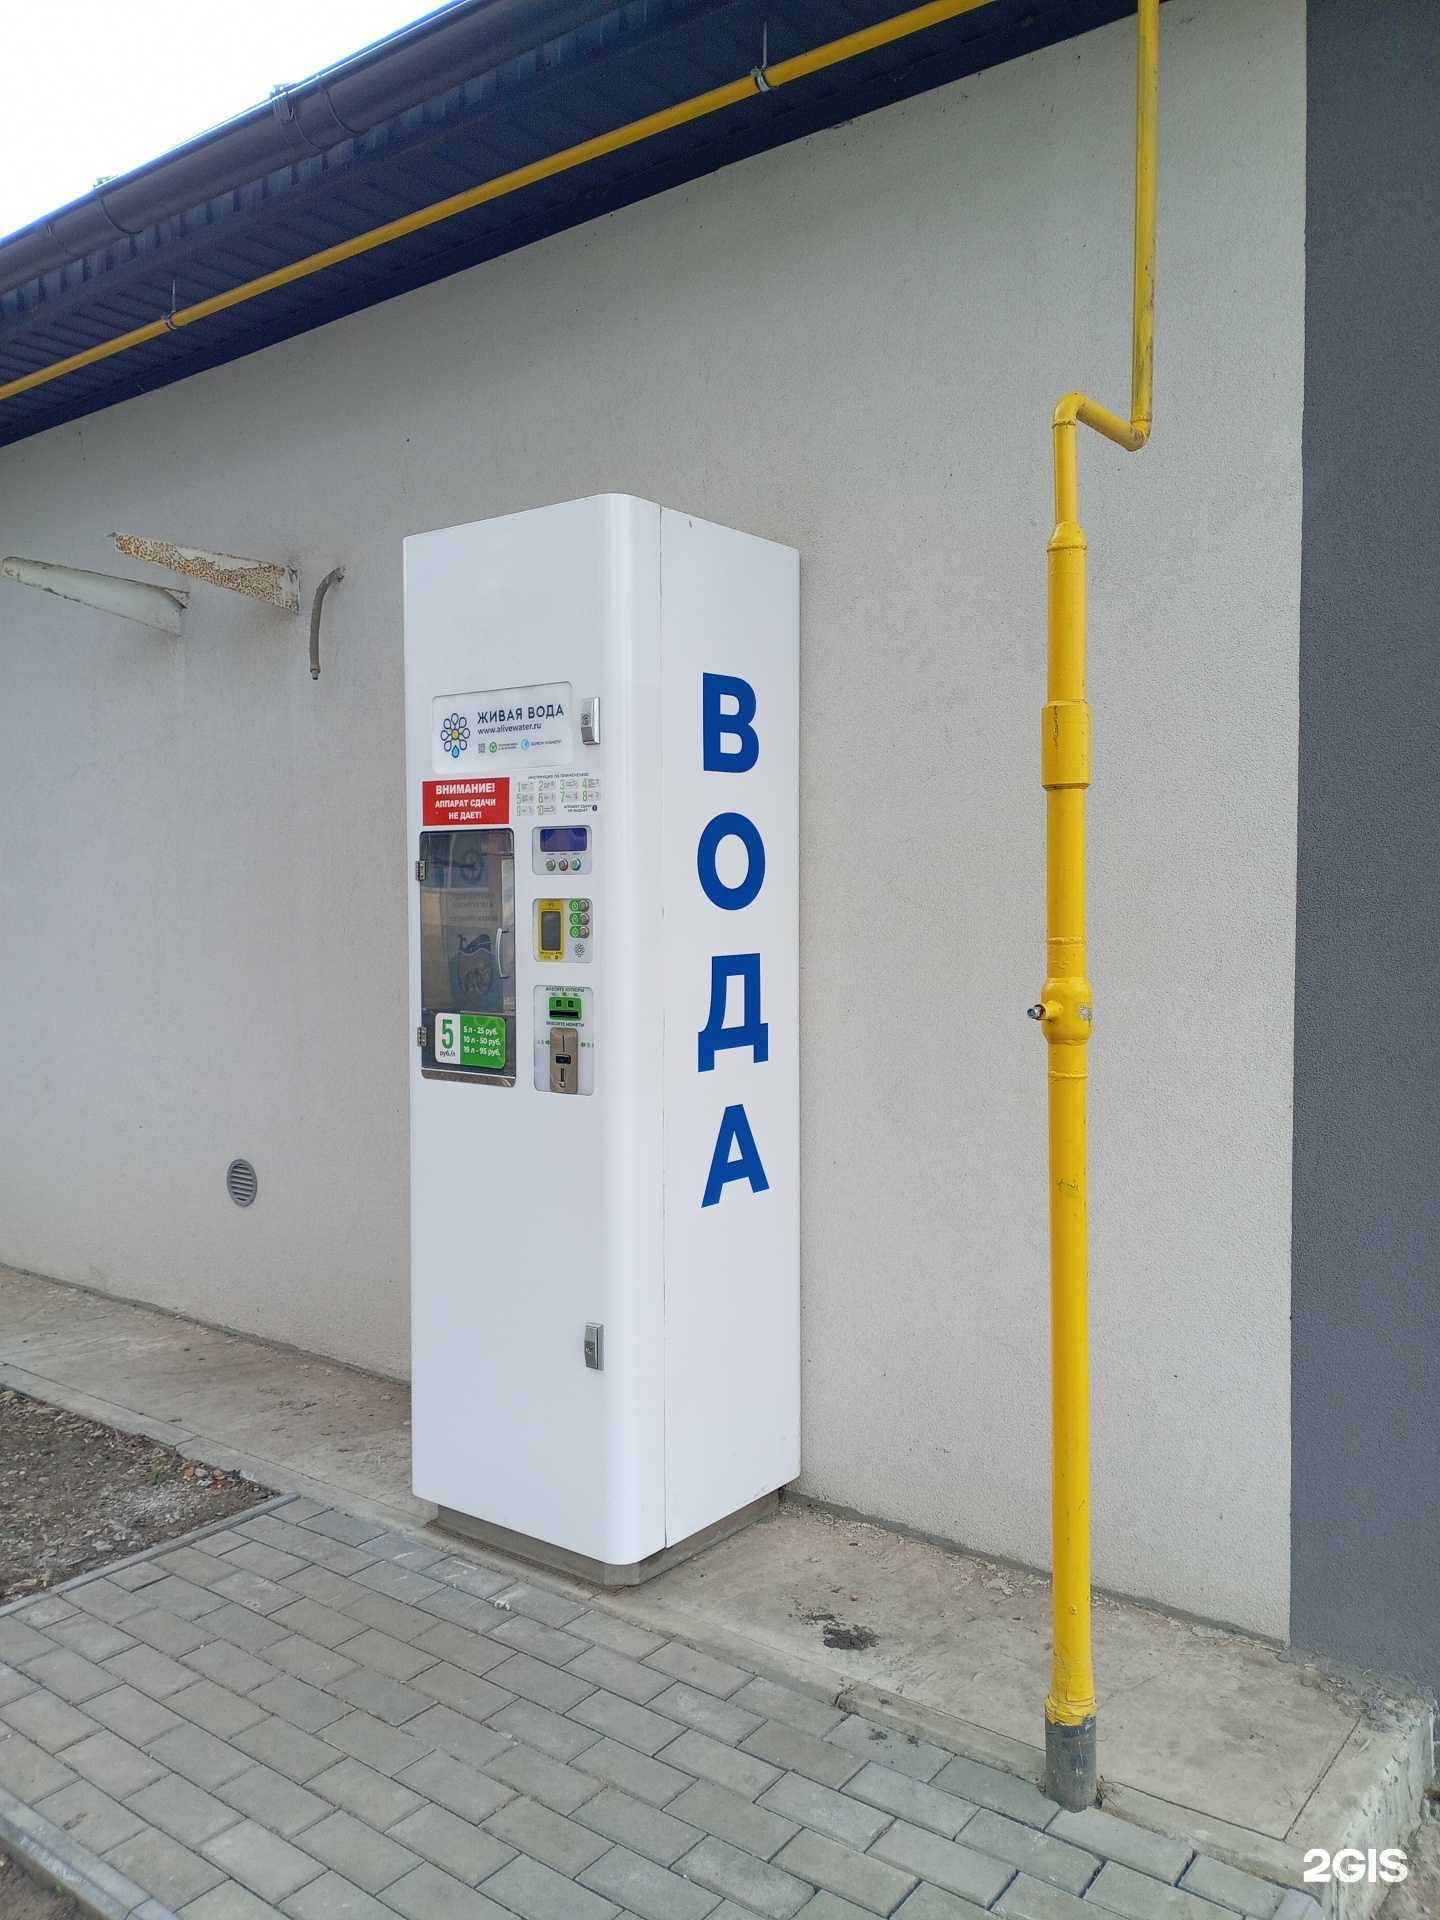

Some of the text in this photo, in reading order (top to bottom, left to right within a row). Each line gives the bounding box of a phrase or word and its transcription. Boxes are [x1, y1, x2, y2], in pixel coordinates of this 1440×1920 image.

[477, 703, 564, 724] ЖИВАЯ ВОДА
[477, 722, 542, 735] www.alivewater.ru
[435, 782, 496, 795] ВНИМАНИЕ!
[538, 781, 544, 791] 2
[560, 791, 565, 802] 7
[582, 791, 588, 801] 8
[435, 798, 496, 808] АППАРАТ СДАЧИ
[448, 810, 482, 820] НЕ ДАЕТ!
[697, 672, 769, 1208] ВОДА
[441, 1019, 454, 1049] 5
[477, 1026, 484, 1034] 25
[485, 1027, 498, 1036] руб.
[488, 1038, 501, 1046] руб.
[487, 1048, 501, 1057] руб.
